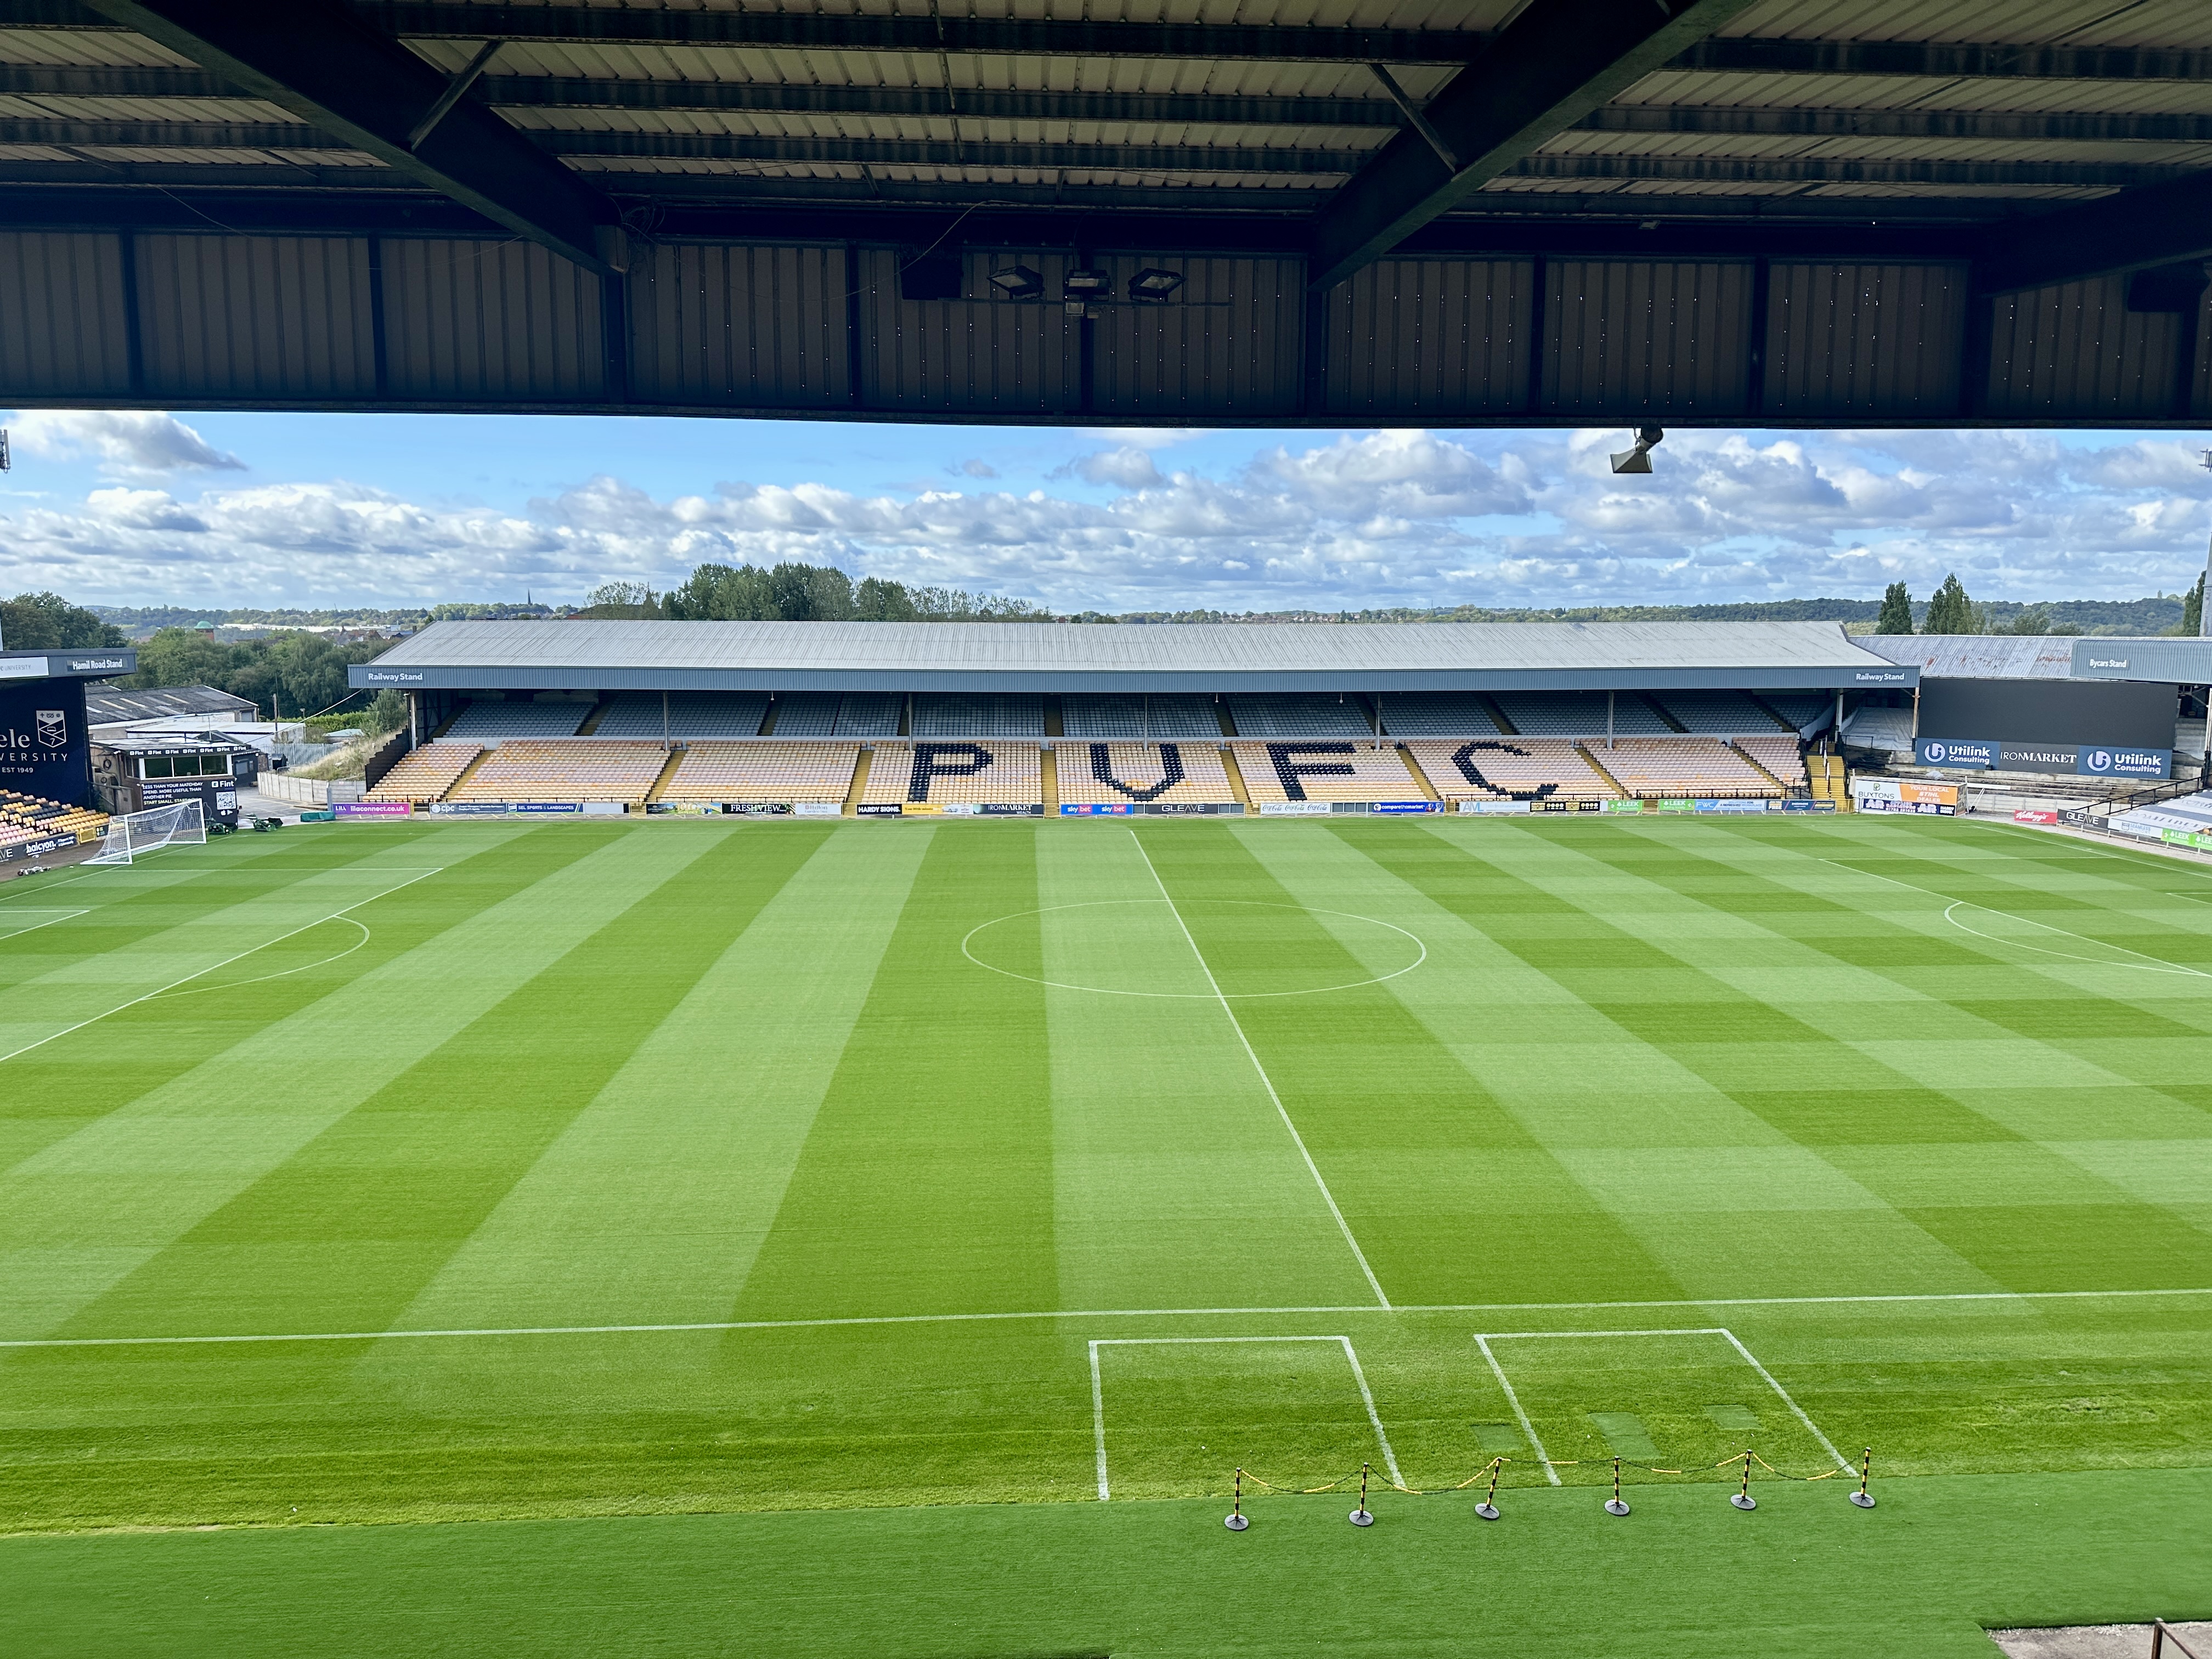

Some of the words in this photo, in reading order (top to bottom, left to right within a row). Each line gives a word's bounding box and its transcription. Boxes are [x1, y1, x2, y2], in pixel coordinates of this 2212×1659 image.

[72, 660, 90, 670] Hamil
[91, 659, 106, 669] Road
[106, 658, 122, 668] Stand
[2090, 658, 2108, 669] Bycars
[2109, 659, 2127, 668] Stand
[368, 673, 399, 682] Railway
[1856, 673, 1883, 682] Railway
[1949, 746, 1990, 757] Utilink
[1949, 755, 1990, 765] Consulting
[2000, 752, 2076, 763] IRONMARKET
[2115, 753, 2162, 765] Utilink
[2114, 764, 2161, 774] Consulting
[1463, 802, 1484, 811] AML
[2016, 811, 2047, 821] Kellogg's
[2067, 812, 2099, 825] GLEAVE
[2130, 823, 2151, 831] SEAMLESS
[2175, 832, 2189, 840] LEEK
